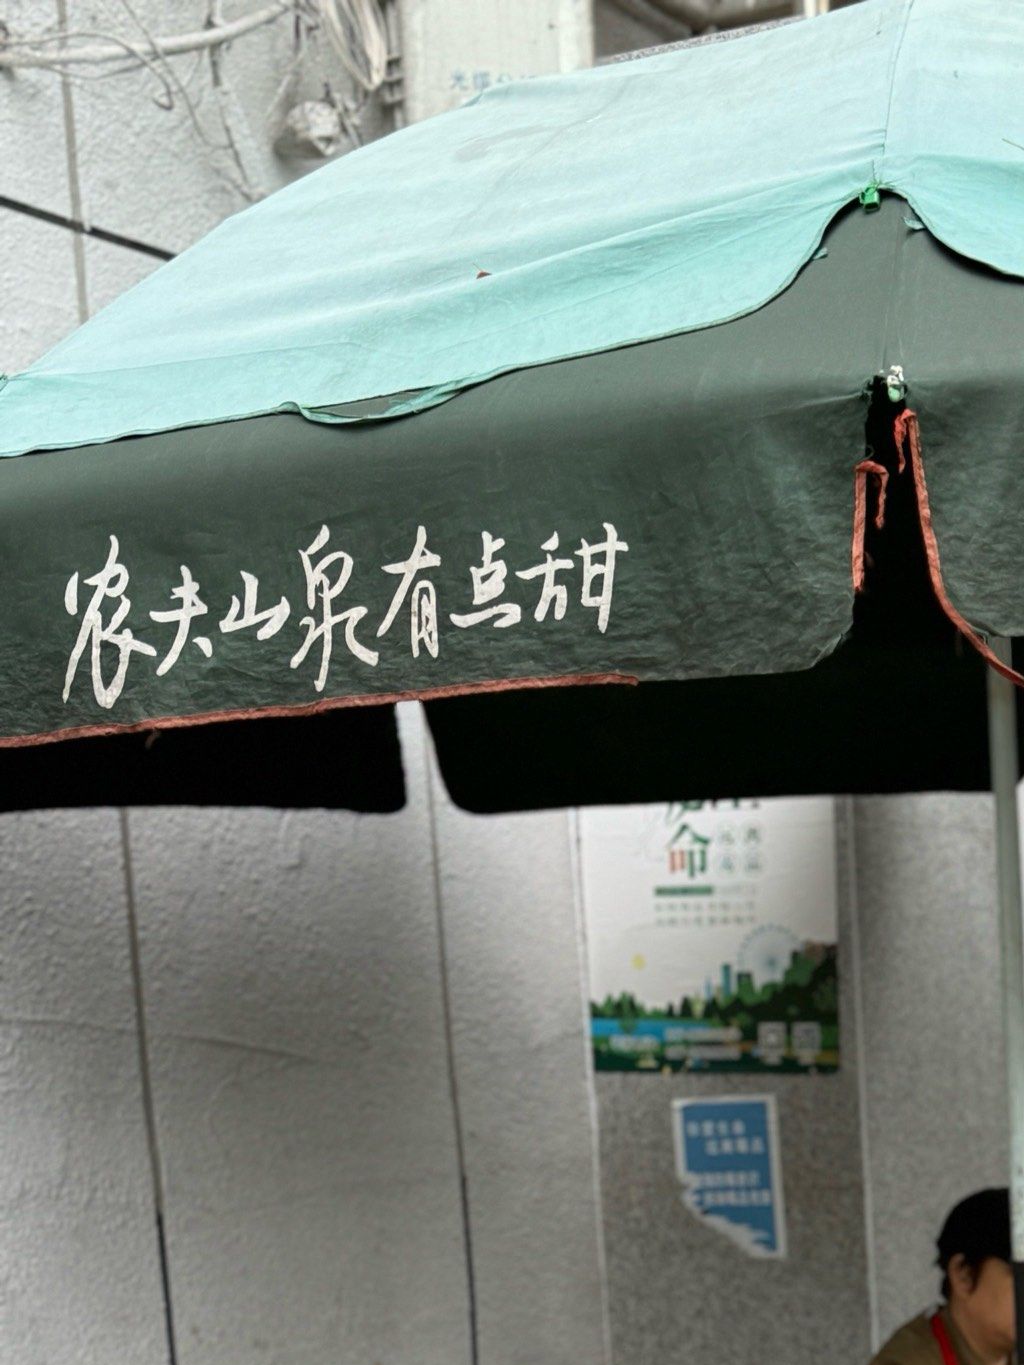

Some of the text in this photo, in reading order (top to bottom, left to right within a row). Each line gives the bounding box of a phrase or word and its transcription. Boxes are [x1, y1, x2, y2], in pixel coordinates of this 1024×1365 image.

[63, 523, 629, 710] 农夫山泉有点甜
